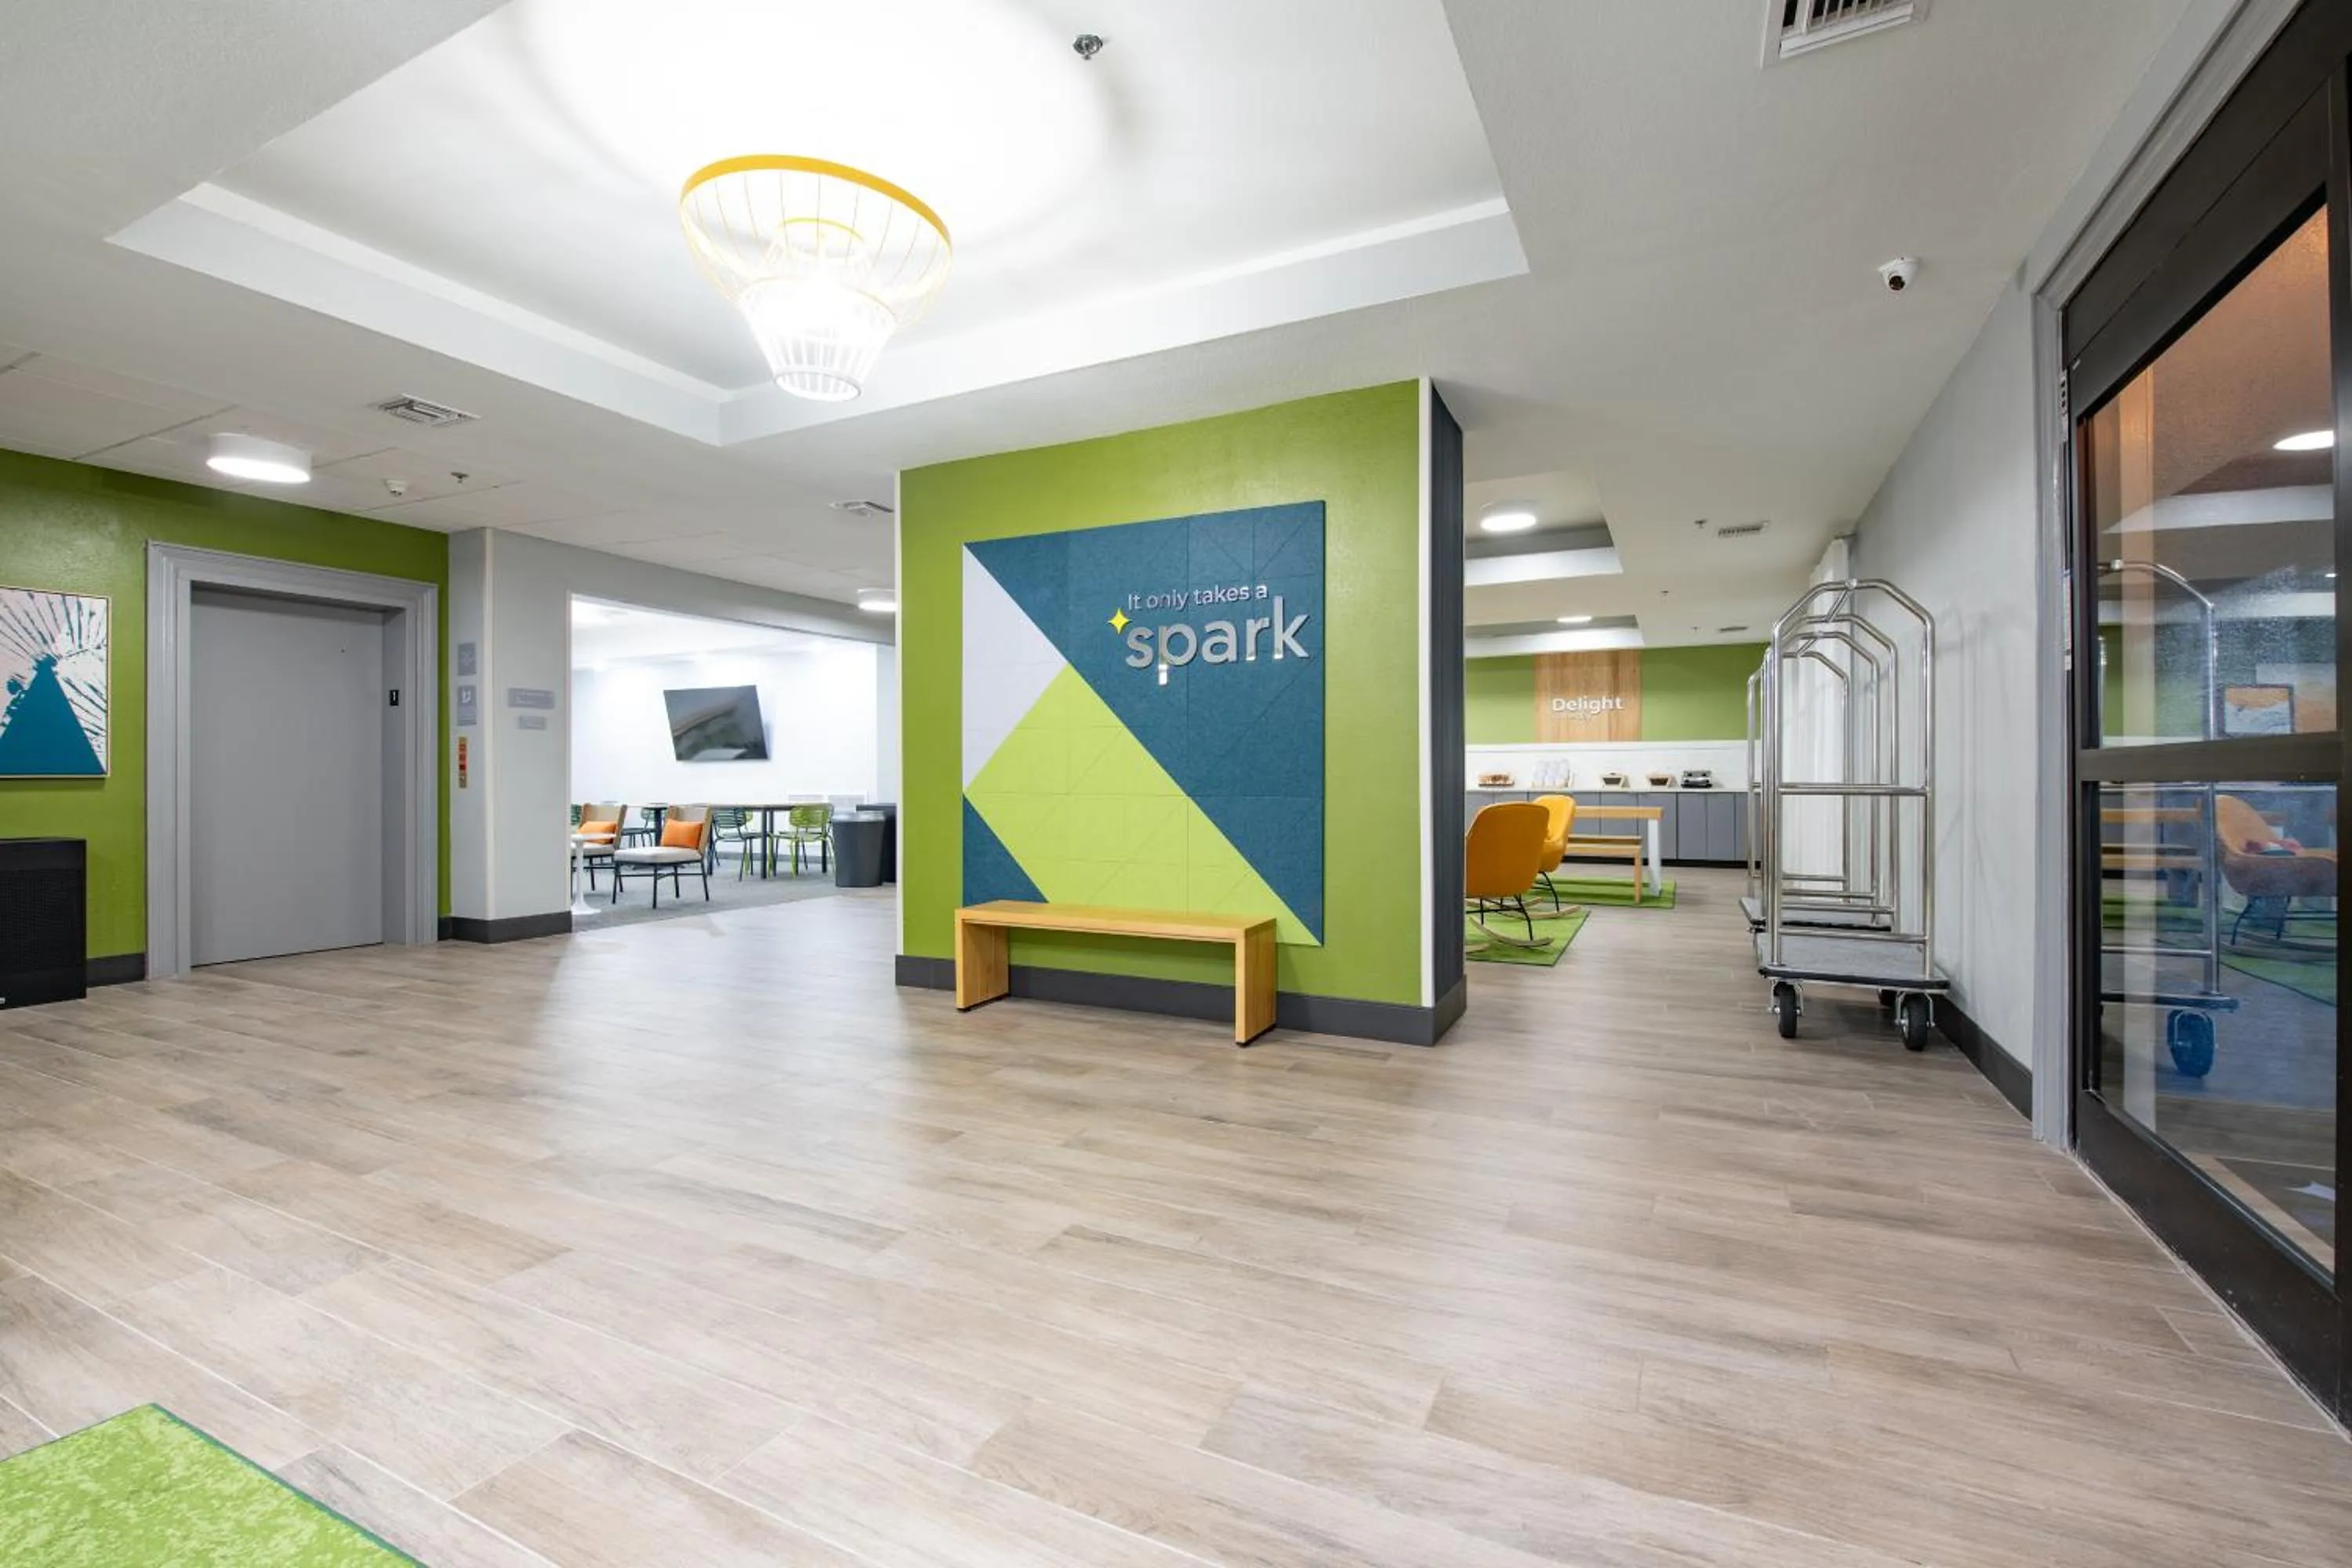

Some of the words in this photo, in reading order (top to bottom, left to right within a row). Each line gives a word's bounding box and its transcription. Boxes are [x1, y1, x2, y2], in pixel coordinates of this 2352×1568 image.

[1127, 593, 1142, 611] It
[1146, 589, 1188, 611] only
[1194, 584, 1250, 604] takes
[1255, 584, 1268, 598] a
[1125, 596, 1310, 685] spark
[1552, 695, 1624, 714] Delight
